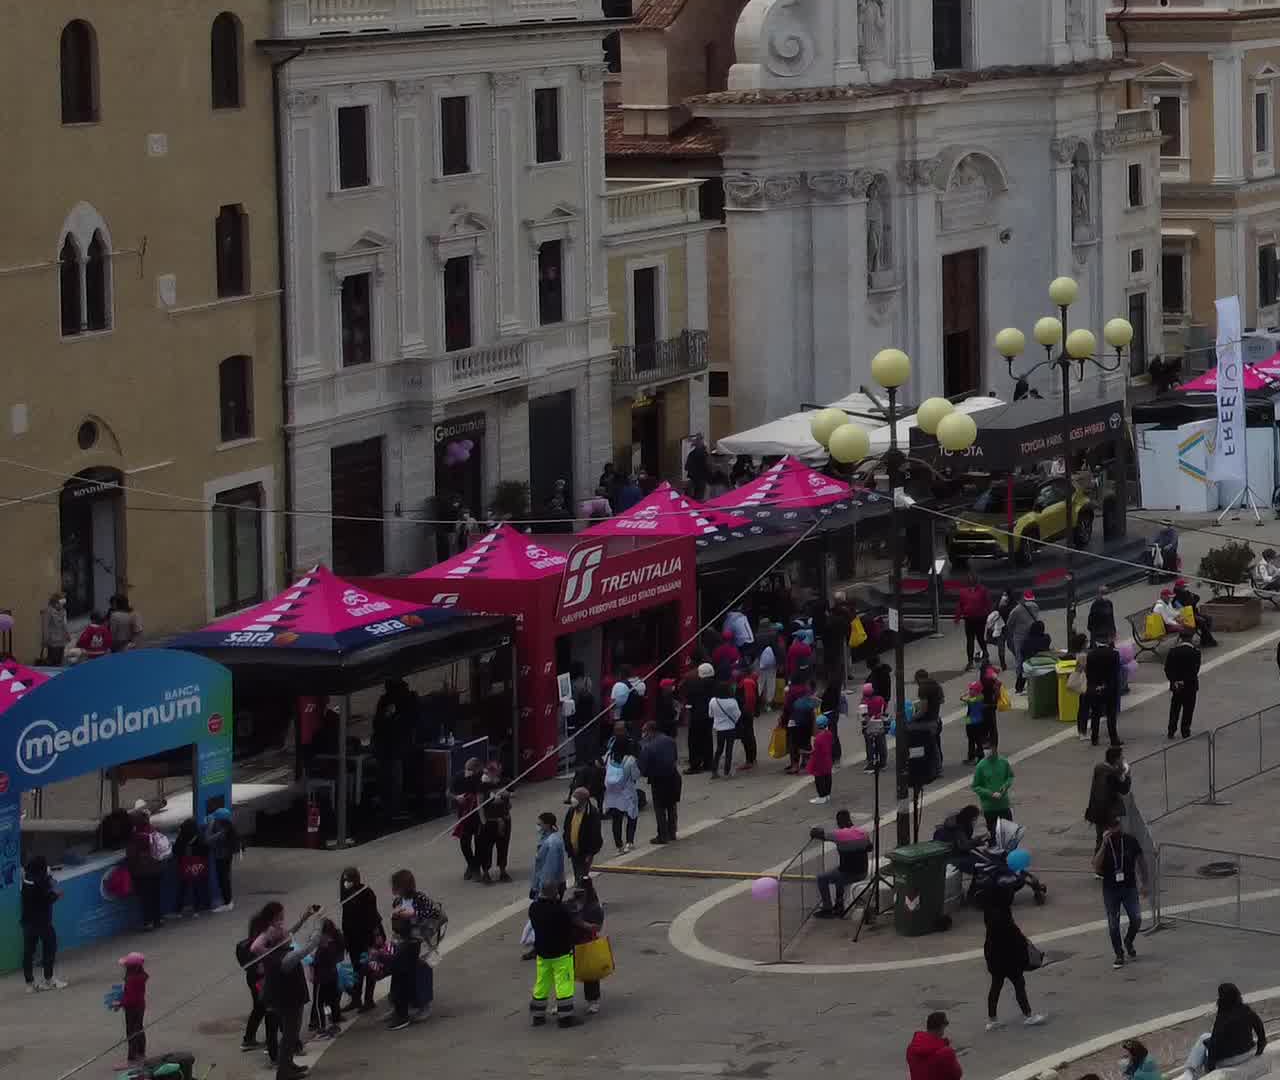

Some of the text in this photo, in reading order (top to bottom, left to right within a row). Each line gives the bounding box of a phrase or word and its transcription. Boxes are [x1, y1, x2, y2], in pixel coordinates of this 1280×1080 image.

[600, 555, 683, 595] TRENITALIA
[365, 618, 405, 636] sara
[223, 632, 275, 643] sara
[164, 684, 201, 701] BANCA
[25, 695, 201, 762] mediolanum
